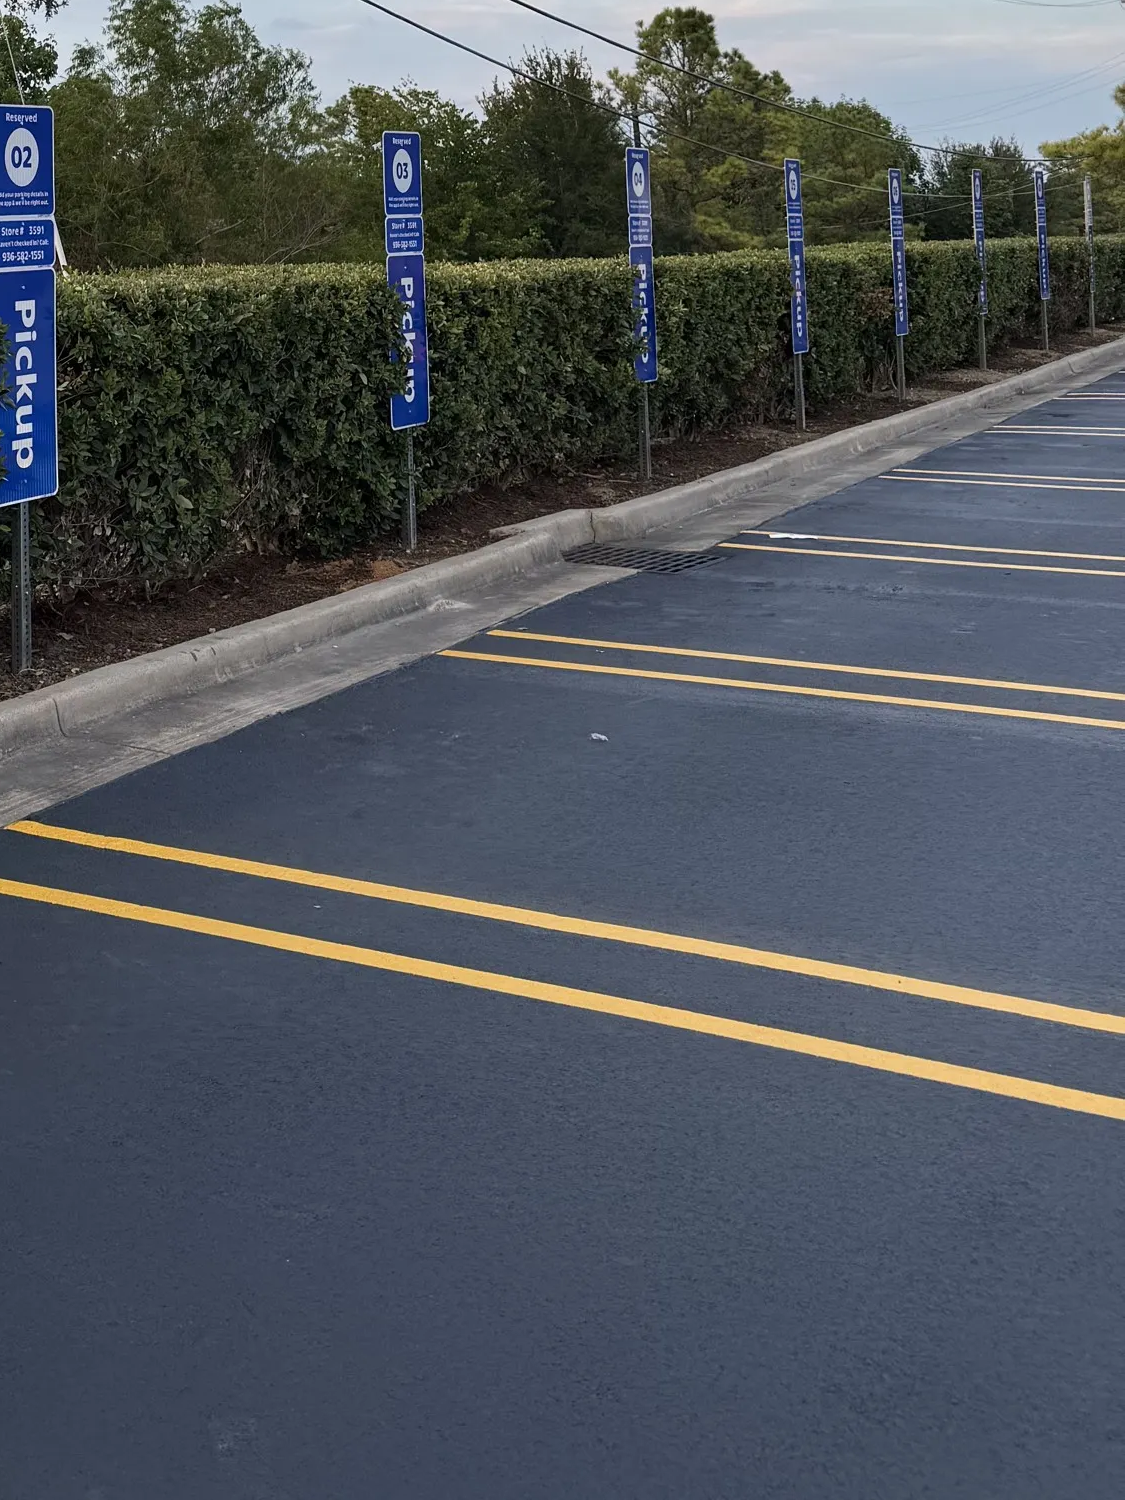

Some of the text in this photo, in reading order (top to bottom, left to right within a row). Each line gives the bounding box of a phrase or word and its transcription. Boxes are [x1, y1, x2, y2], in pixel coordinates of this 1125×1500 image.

[5, 112, 38, 122] Reserved
[11, 146, 32, 168] 02
[396, 162, 409, 179] 03
[634, 173, 643, 186] 04
[1, 227, 19, 236] Store
[29, 225, 44, 235] 3591
[2, 250, 44, 261] 936-582-1551
[12, 300, 37, 469] Pickup
